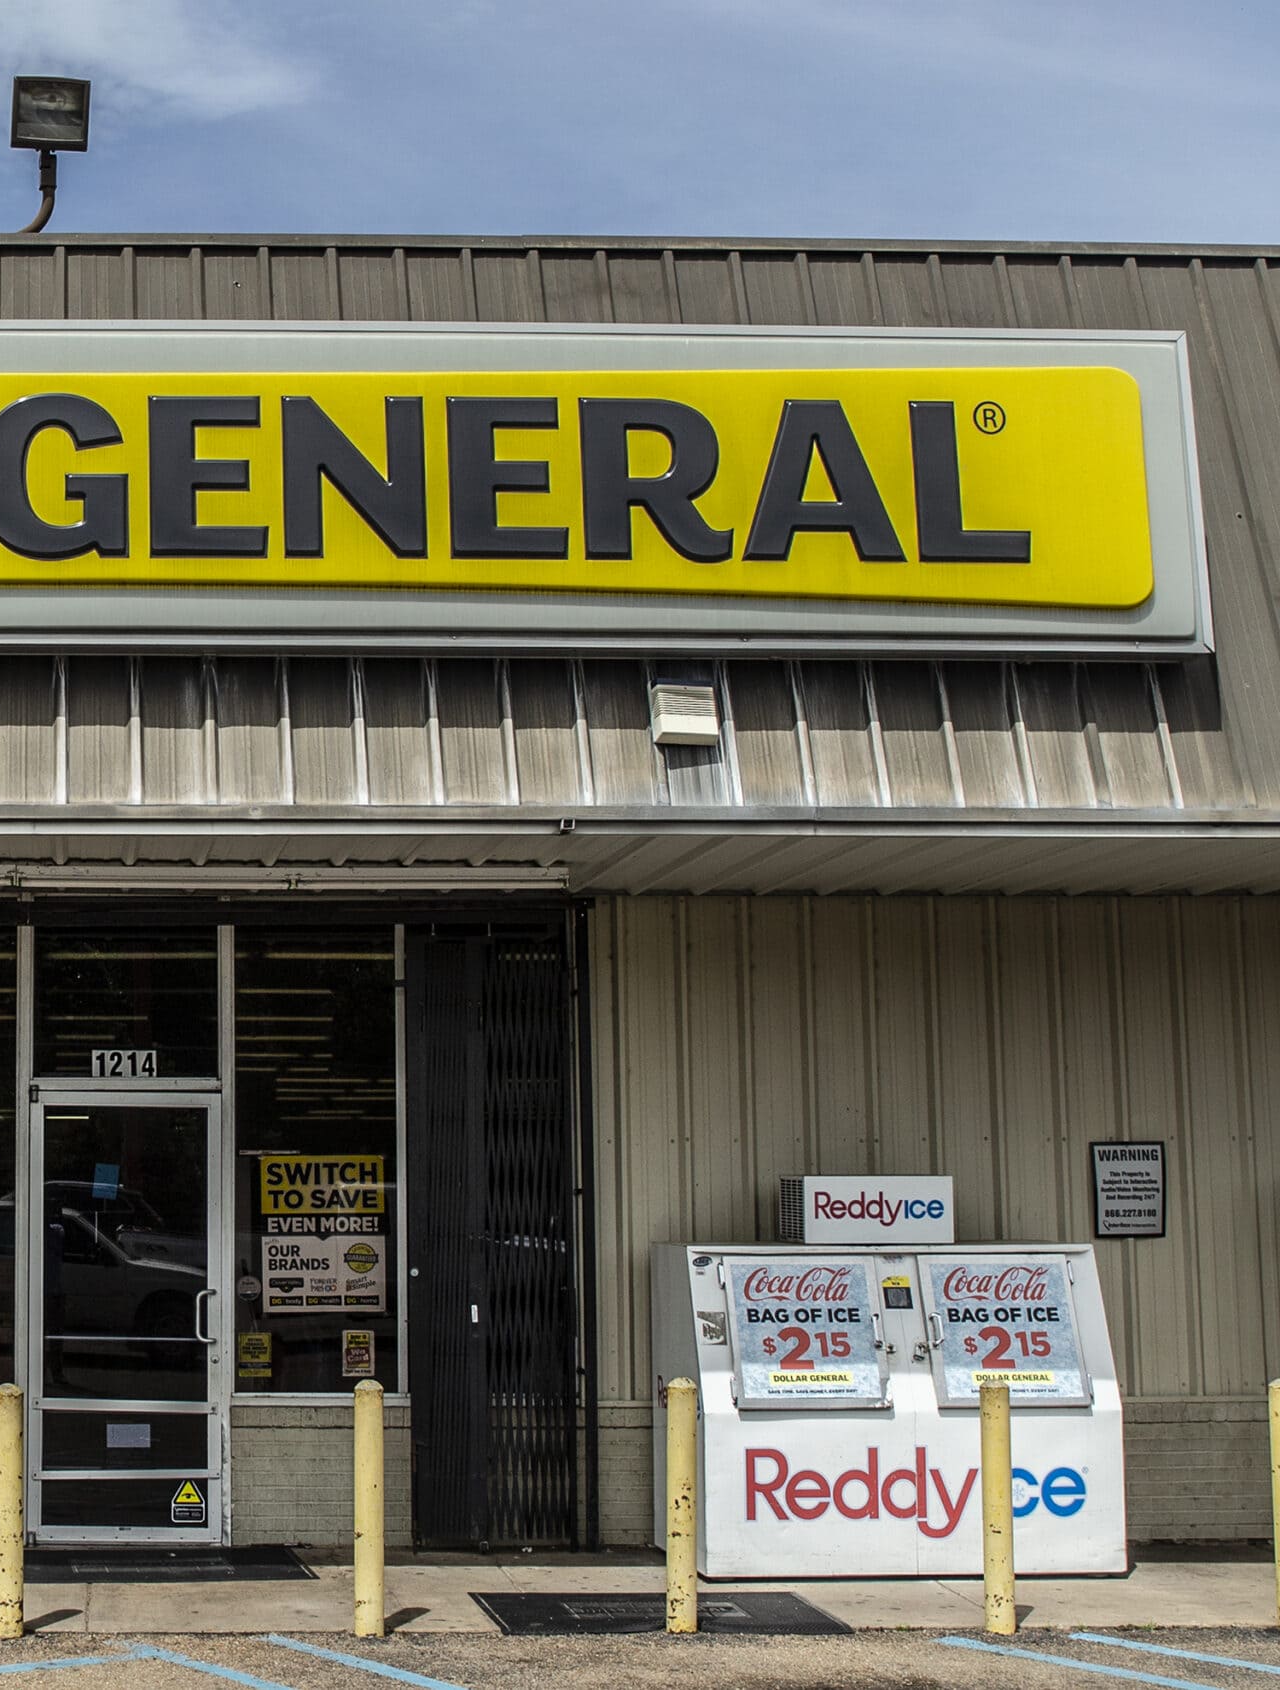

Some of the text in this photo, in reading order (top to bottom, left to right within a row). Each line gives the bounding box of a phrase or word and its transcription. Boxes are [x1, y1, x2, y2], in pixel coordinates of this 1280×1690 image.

[95, 1051, 155, 1077] 1214
[1098, 1149, 1159, 1162] WARNING
[266, 1161, 378, 1186] SWITCH
[267, 1188, 378, 1210] TO SAVE
[267, 1216, 379, 1233] EVEN MORE!
[268, 1245, 301, 1257] OUR
[268, 1258, 330, 1271] BRANDS
[743, 1266, 852, 1302] Coca-Cola
[943, 1266, 1049, 1302] Coca-Cola
[746, 1307, 861, 1323] BAG OF ICE
[947, 1307, 1060, 1323] BAG OF ICE
[773, 1374, 849, 1383] DOLLAR GENERAL
[1012, 1374, 1051, 1382] GENERAL
